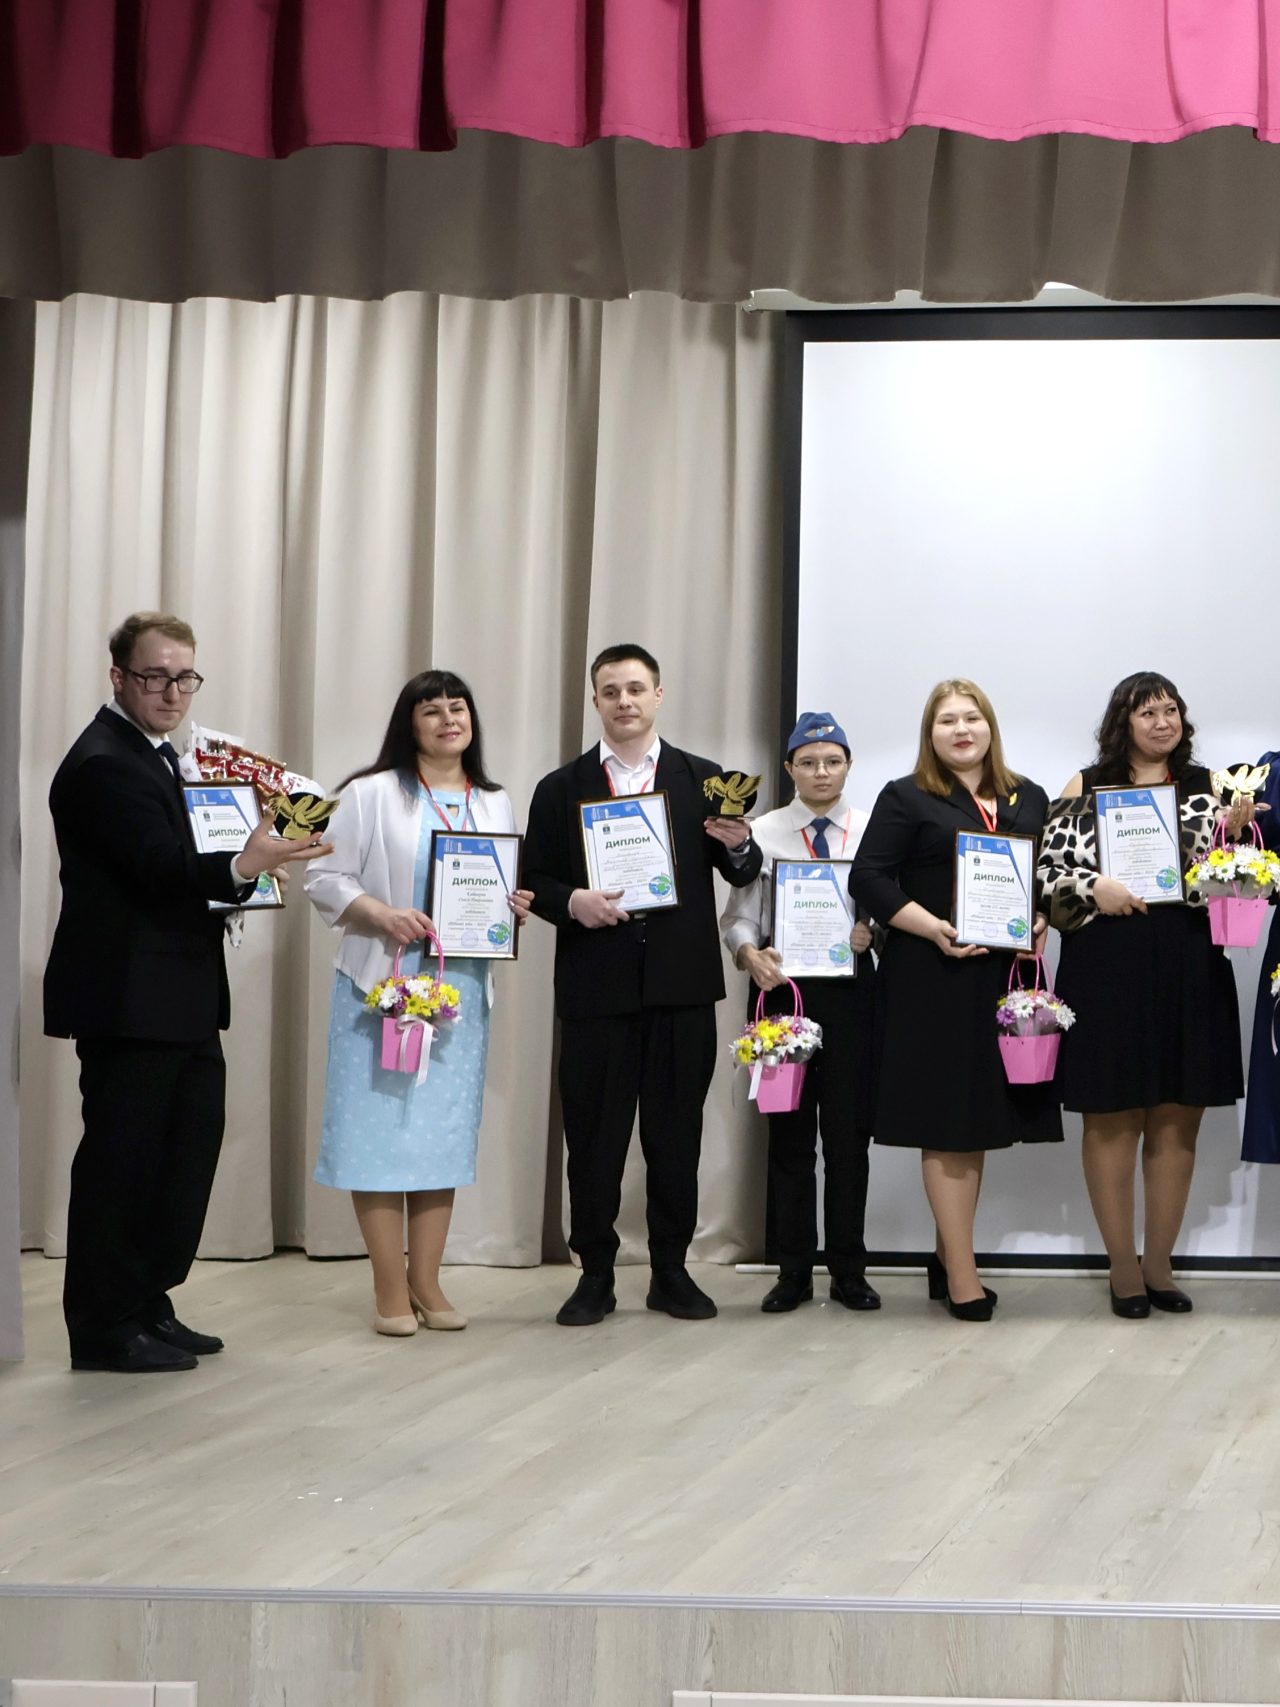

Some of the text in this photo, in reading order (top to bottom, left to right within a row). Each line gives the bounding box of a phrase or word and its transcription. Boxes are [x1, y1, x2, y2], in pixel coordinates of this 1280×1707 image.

[1116, 826, 1161, 838] ДИПЛОМ
[605, 836, 651, 850] ДИПЛОМ
[451, 877, 498, 887] ДИПЛОМ
[973, 872, 1015, 884] ДИПЛОМ
[793, 900, 838, 909] ДИПЛОМ
